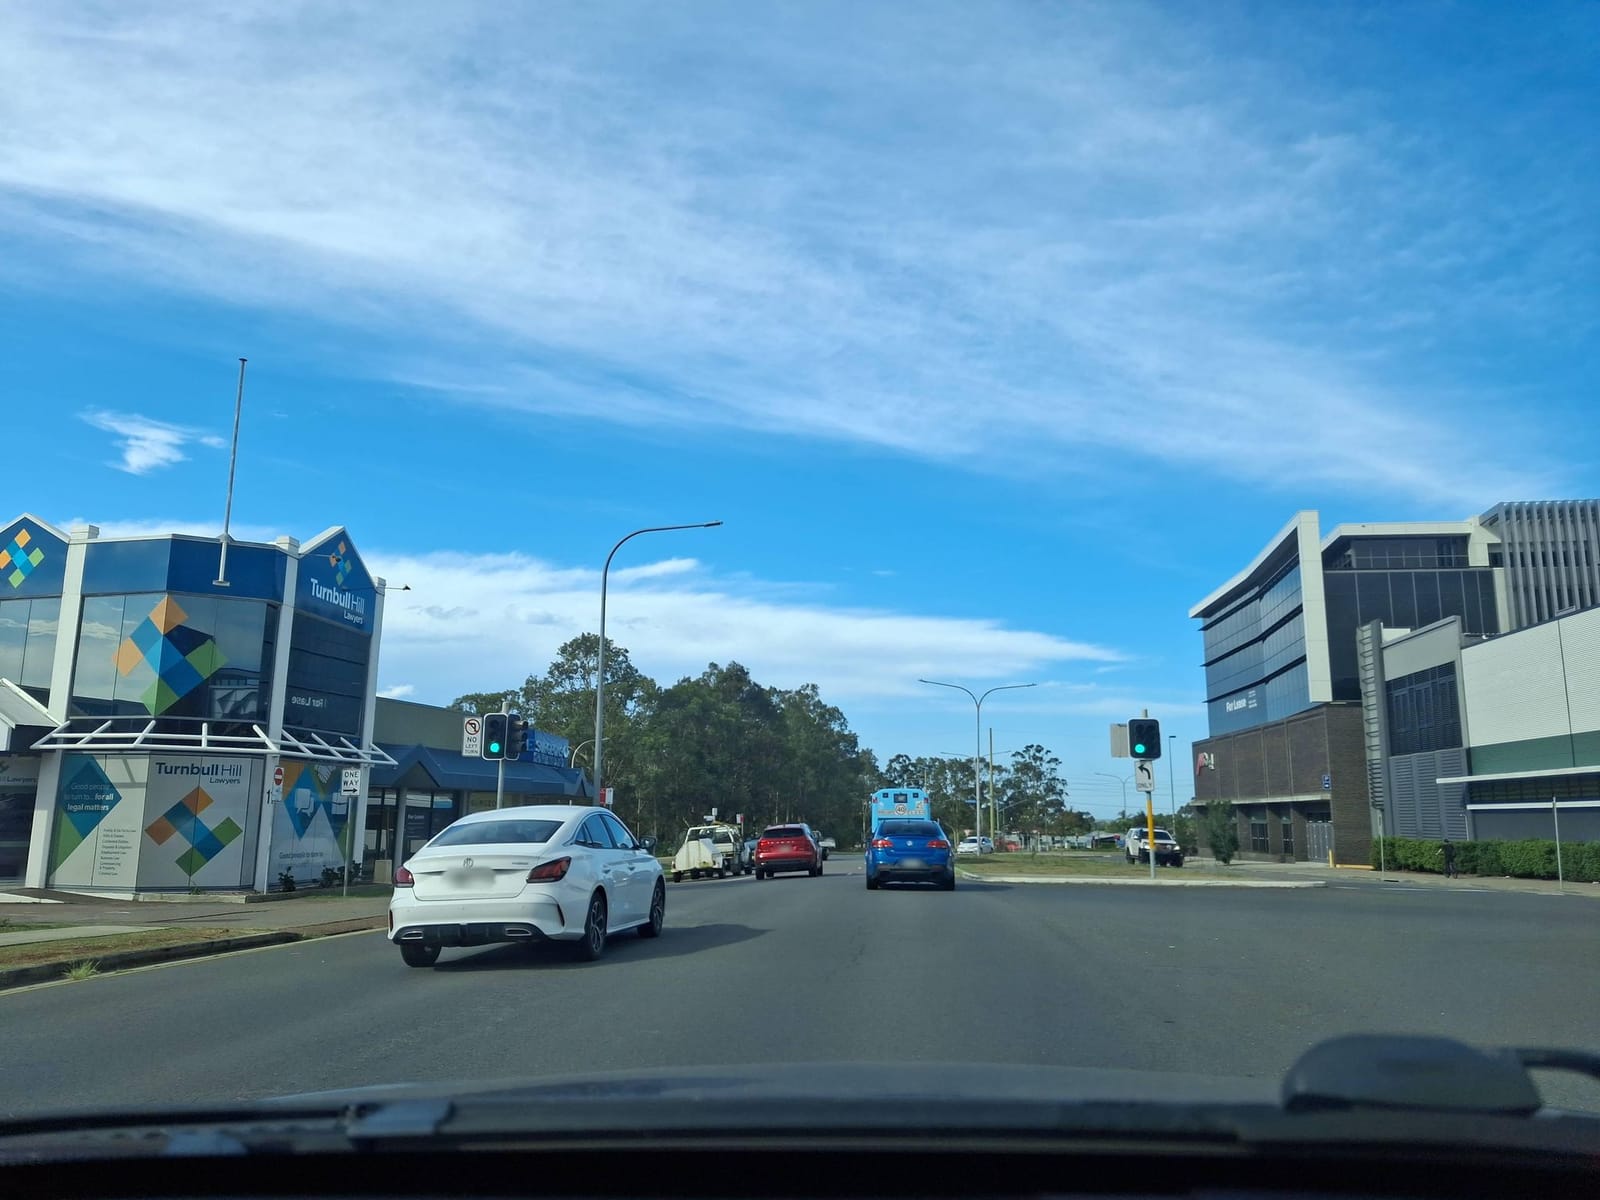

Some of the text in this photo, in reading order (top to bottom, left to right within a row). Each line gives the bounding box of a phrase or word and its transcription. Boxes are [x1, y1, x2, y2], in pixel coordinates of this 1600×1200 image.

[310, 577, 365, 615] Turnbull Hill
[343, 609, 363, 625] Lawyers
[155, 762, 242, 777] Turnbull Hill
[209, 777, 241, 785] Lawyers
[94, 793, 105, 801] for
[105, 793, 114, 801] all
[67, 803, 84, 812] legal
